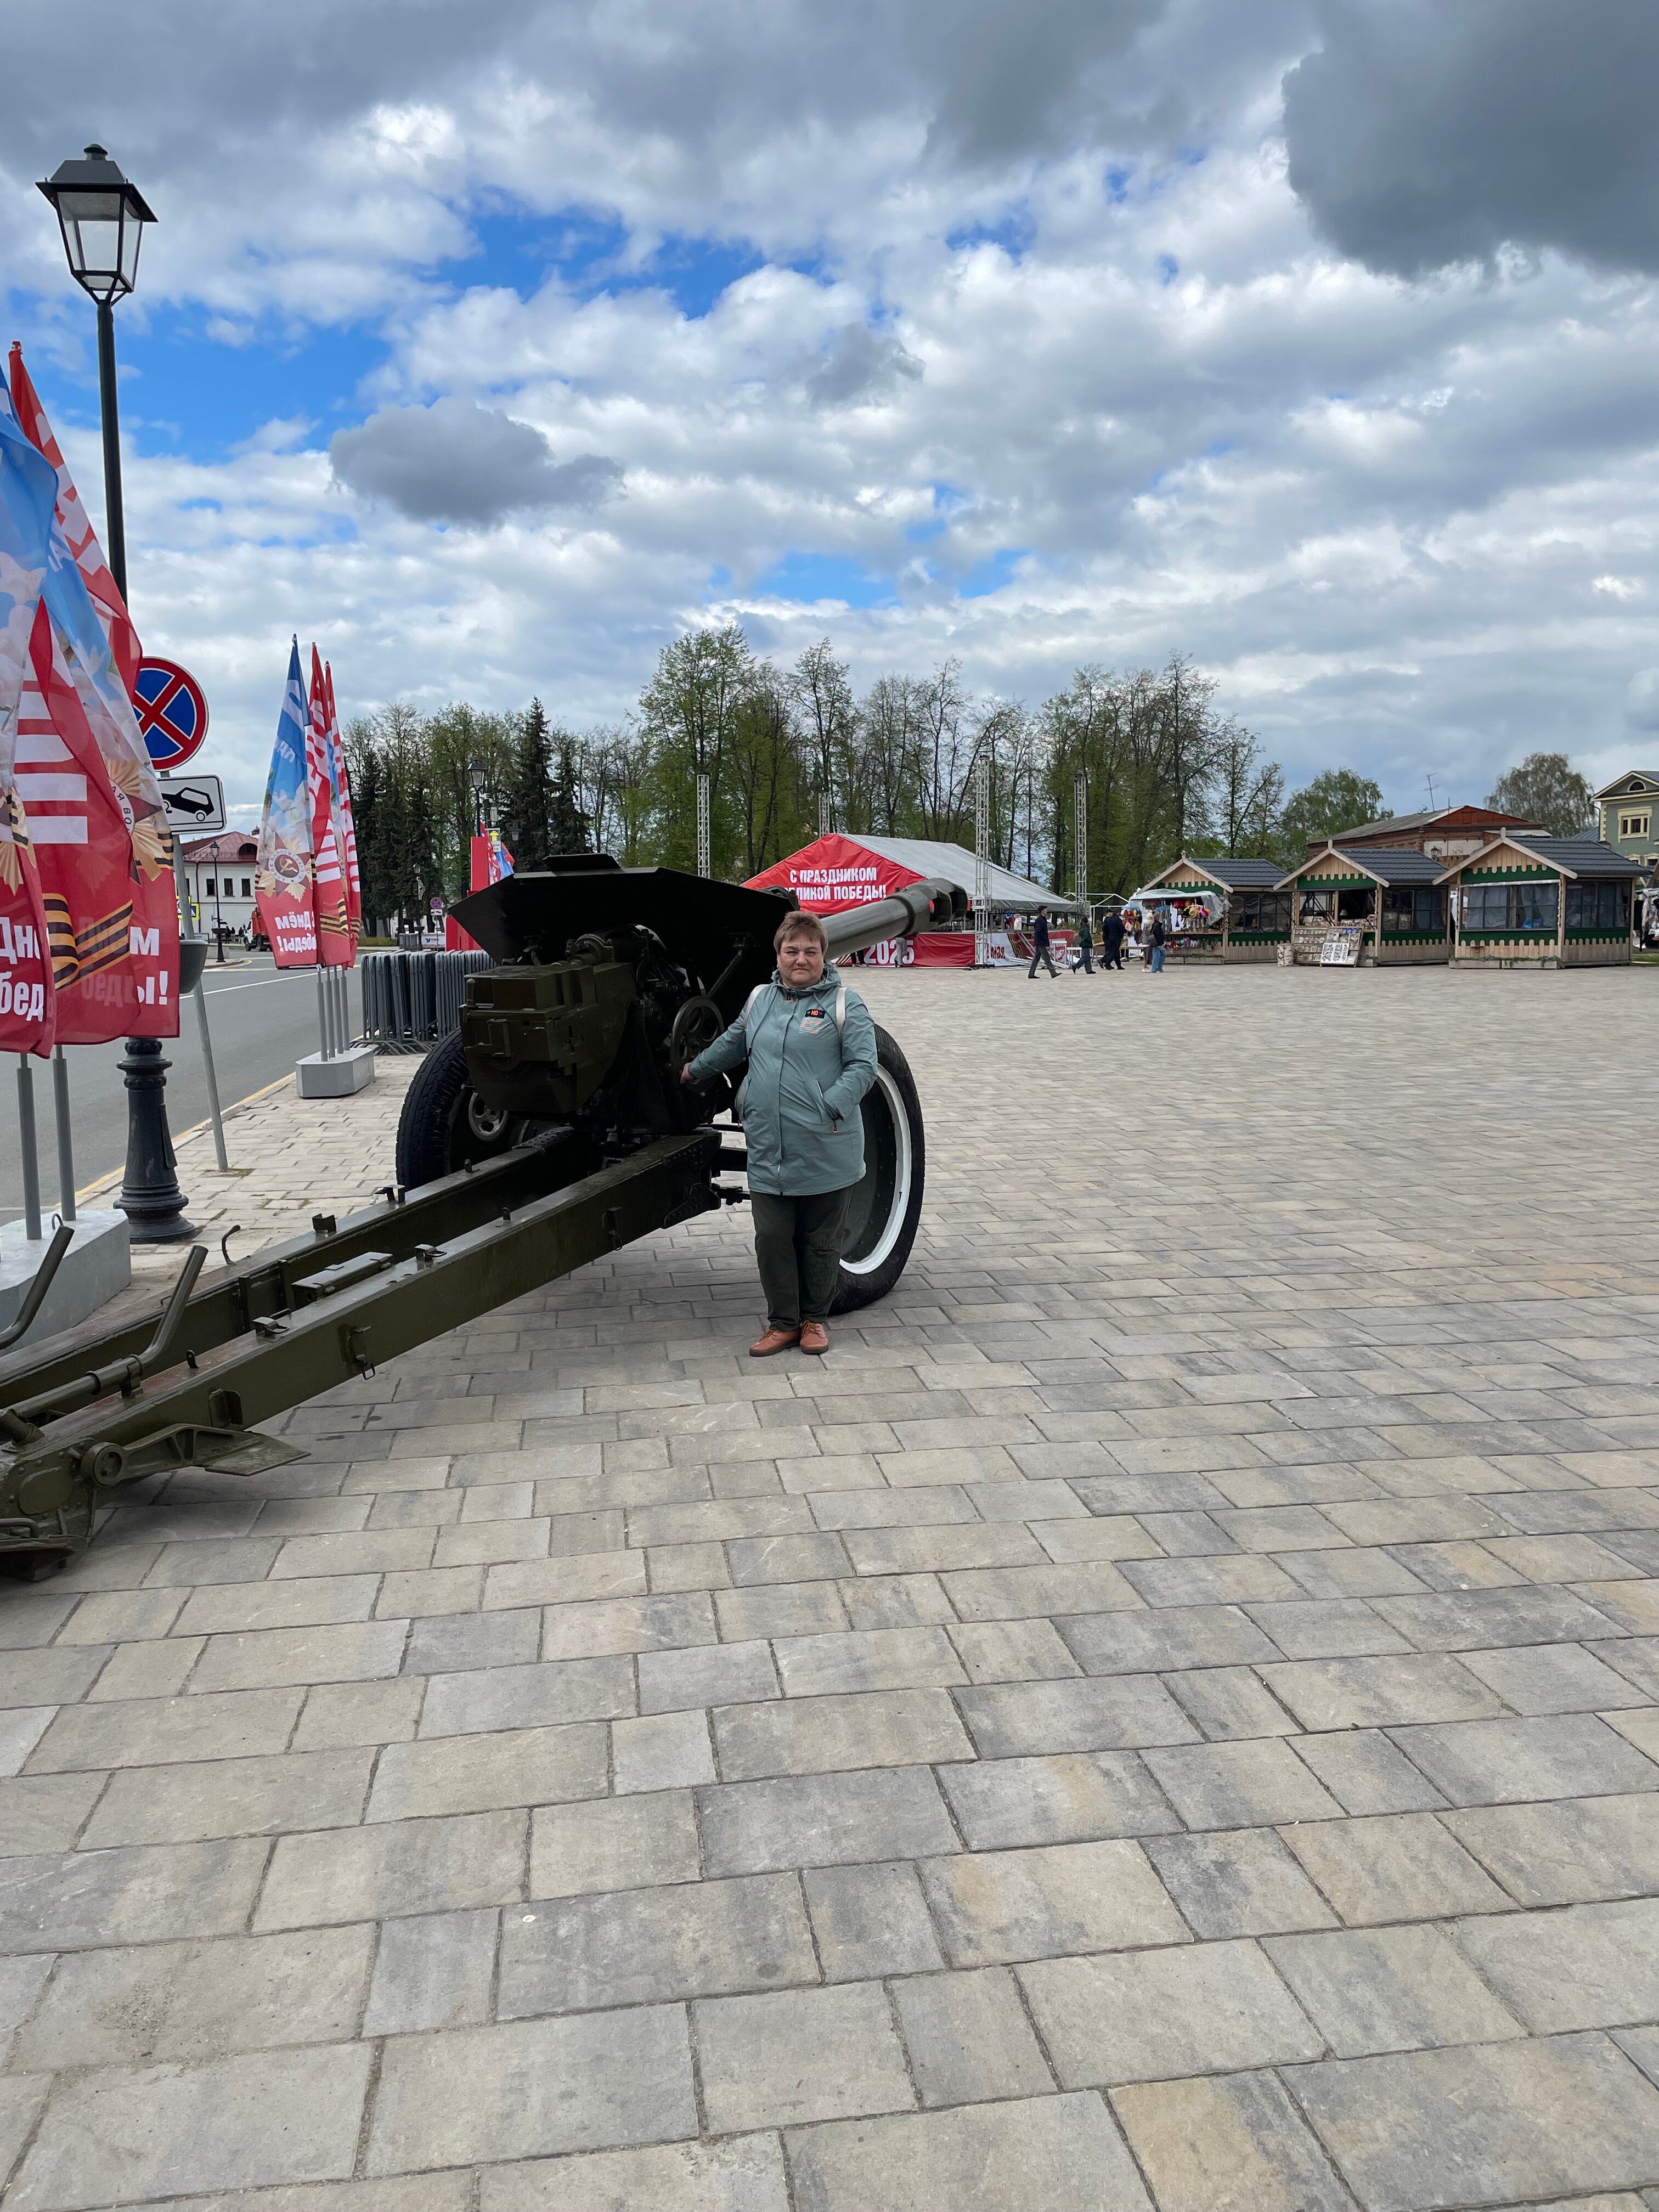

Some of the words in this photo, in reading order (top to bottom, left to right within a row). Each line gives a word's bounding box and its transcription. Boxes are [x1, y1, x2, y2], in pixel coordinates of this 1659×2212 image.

[790, 870, 797, 883] С
[800, 867, 877, 884] ПРАЗДНИКОМ
[784, 885, 831, 900] ЛИКОЙ
[833, 884, 887, 901] ПОБЕДЫ!
[0, 917, 41, 964] Дн
[864, 939, 915, 964] 2025
